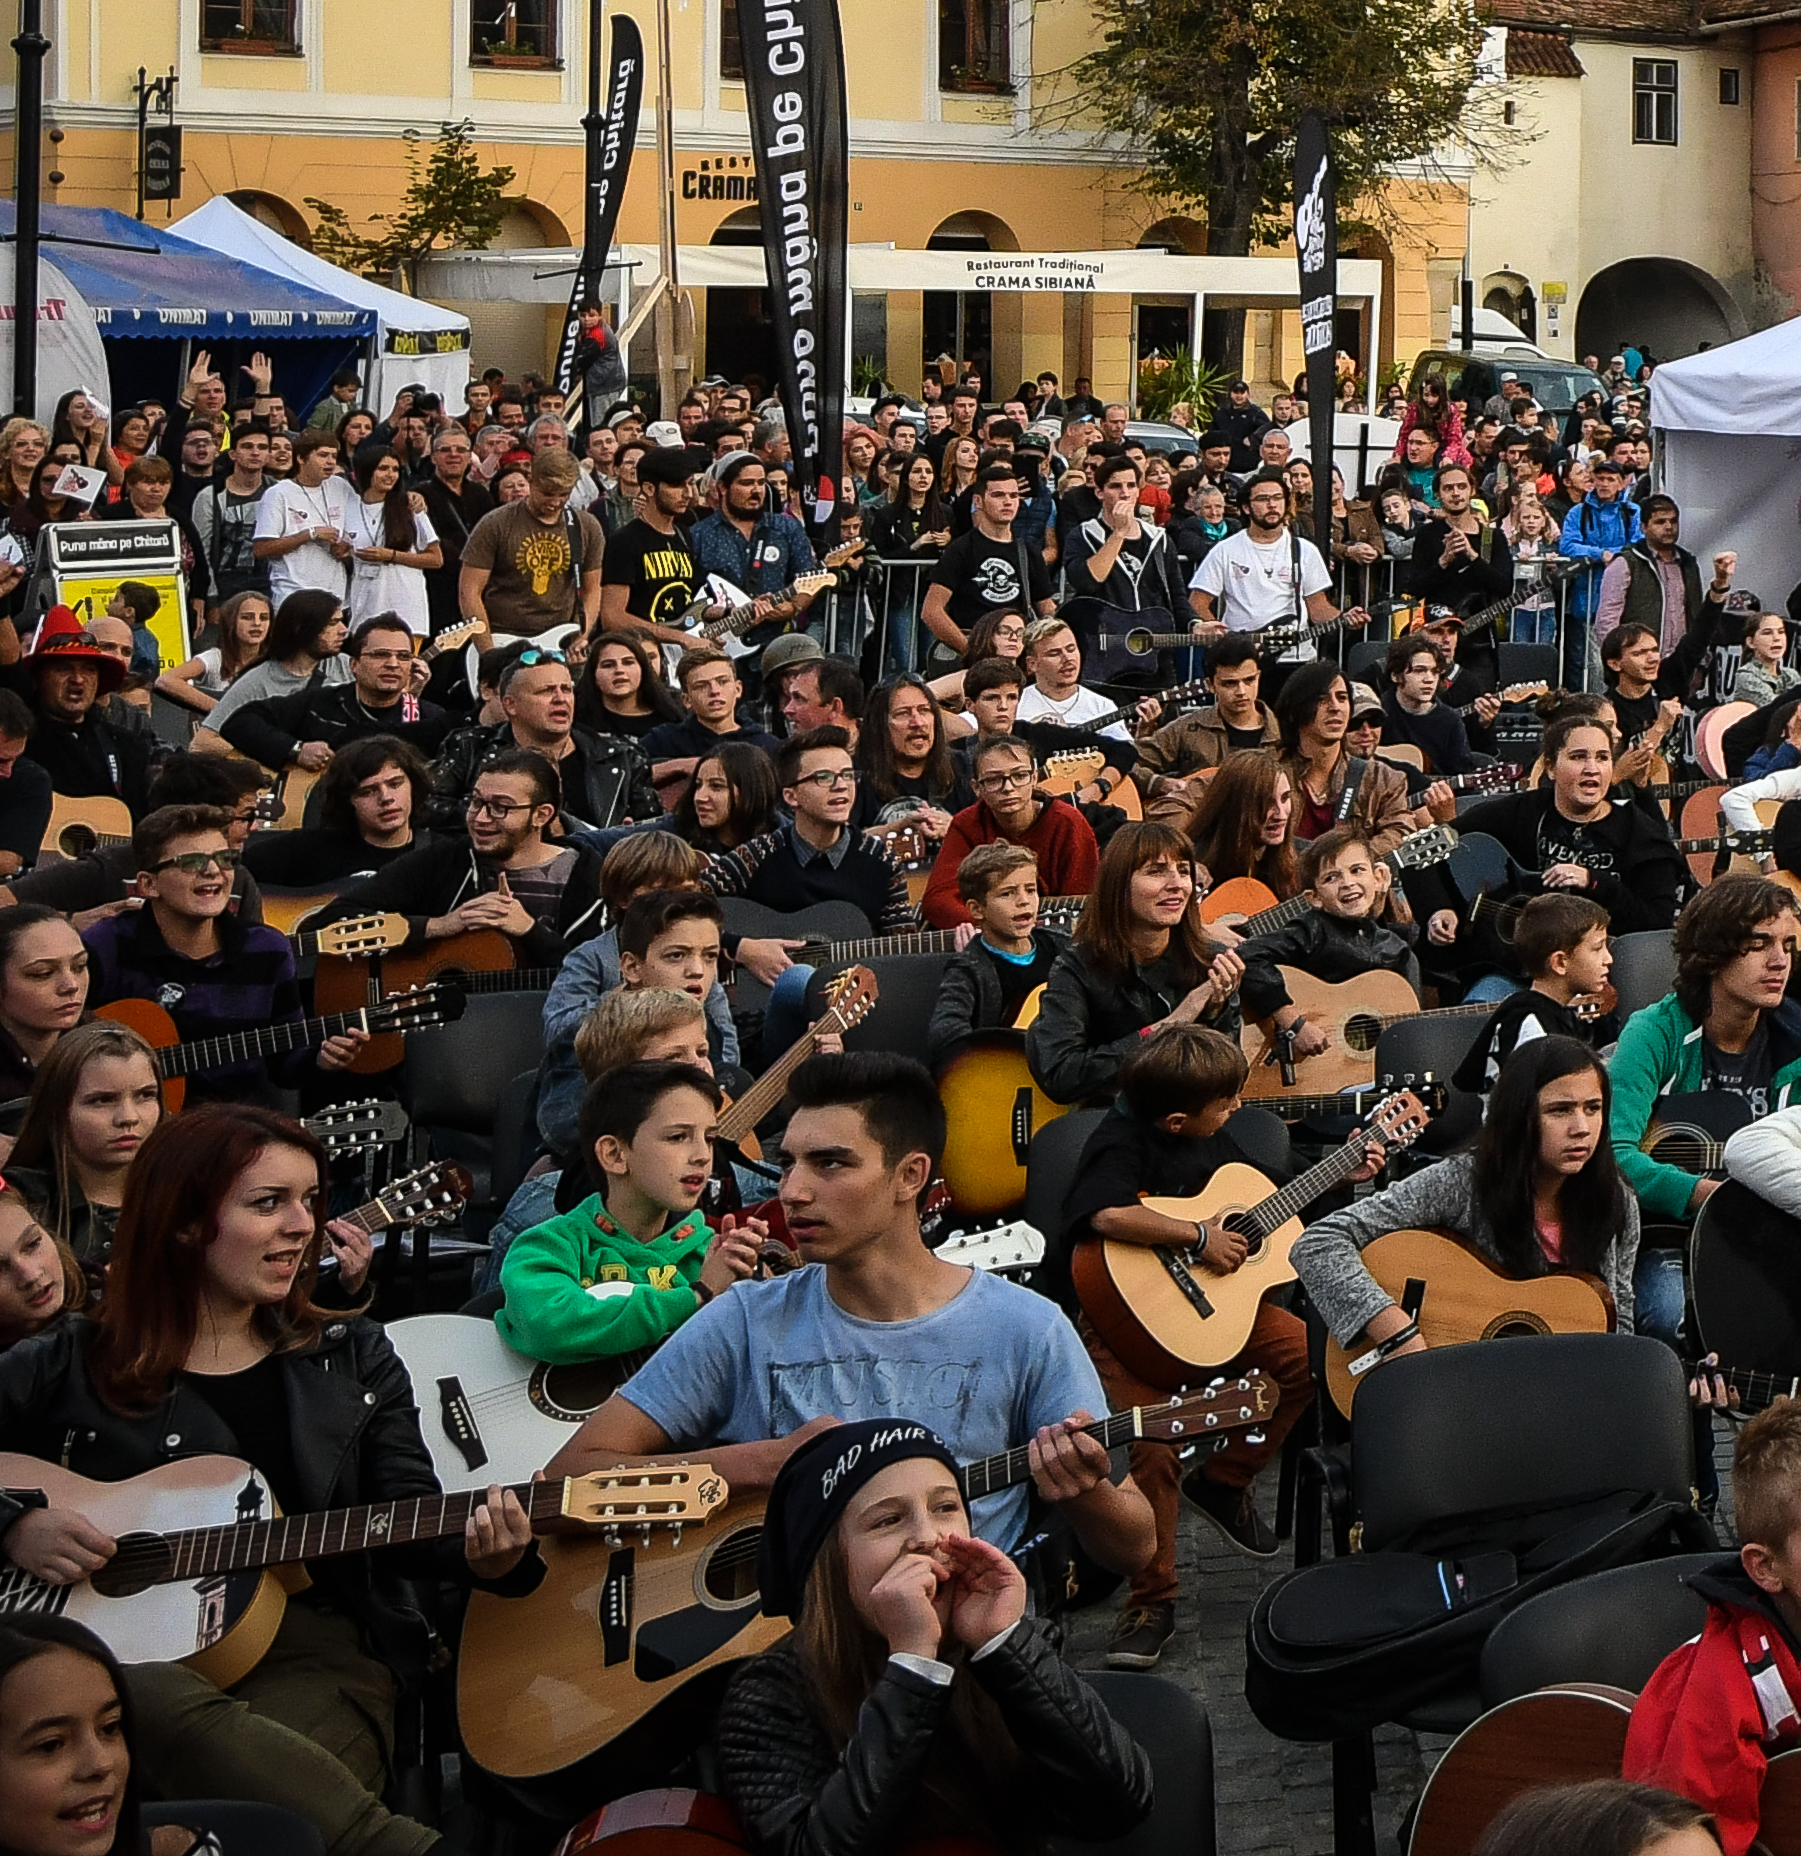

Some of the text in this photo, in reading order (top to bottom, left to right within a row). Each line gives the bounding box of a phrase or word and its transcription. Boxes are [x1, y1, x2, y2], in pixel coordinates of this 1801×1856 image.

[700, 156, 752, 172] REST
[682, 170, 759, 202] CRAMA
[966, 258, 1035, 272] Restaurant
[975, 274, 1096, 290] CRAMA SIBIANĂ
[159, 308, 207, 325] UNIMAT
[250, 309, 293, 326] UNIMAT
[820, 1426, 927, 1500] BAD HAIR
